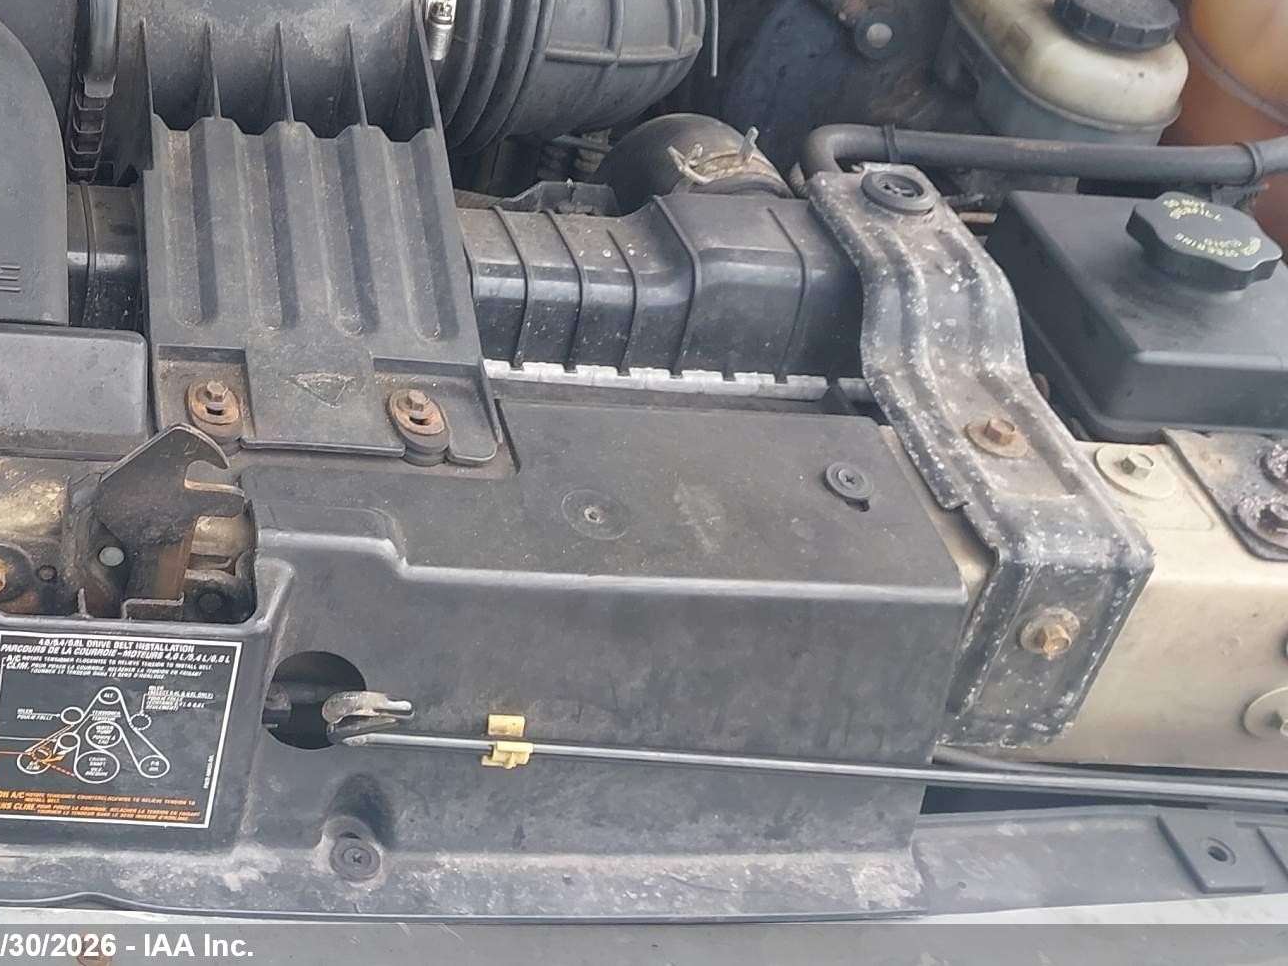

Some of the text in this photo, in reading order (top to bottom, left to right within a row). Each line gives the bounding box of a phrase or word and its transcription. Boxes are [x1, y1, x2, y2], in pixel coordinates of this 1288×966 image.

[0, 644, 46, 654] PARCOURS
[47, 646, 59, 654] DE
[61, 647, 72, 655] LA
[73, 647, 117, 657] COURROIE
[122, 650, 164, 660] MOTEURS
[86, 640, 112, 648] DRIVE
[113, 641, 134, 649] BELT
[135, 642, 195, 653] INSTALLATION
[10, 791, 25, 799] A/C
